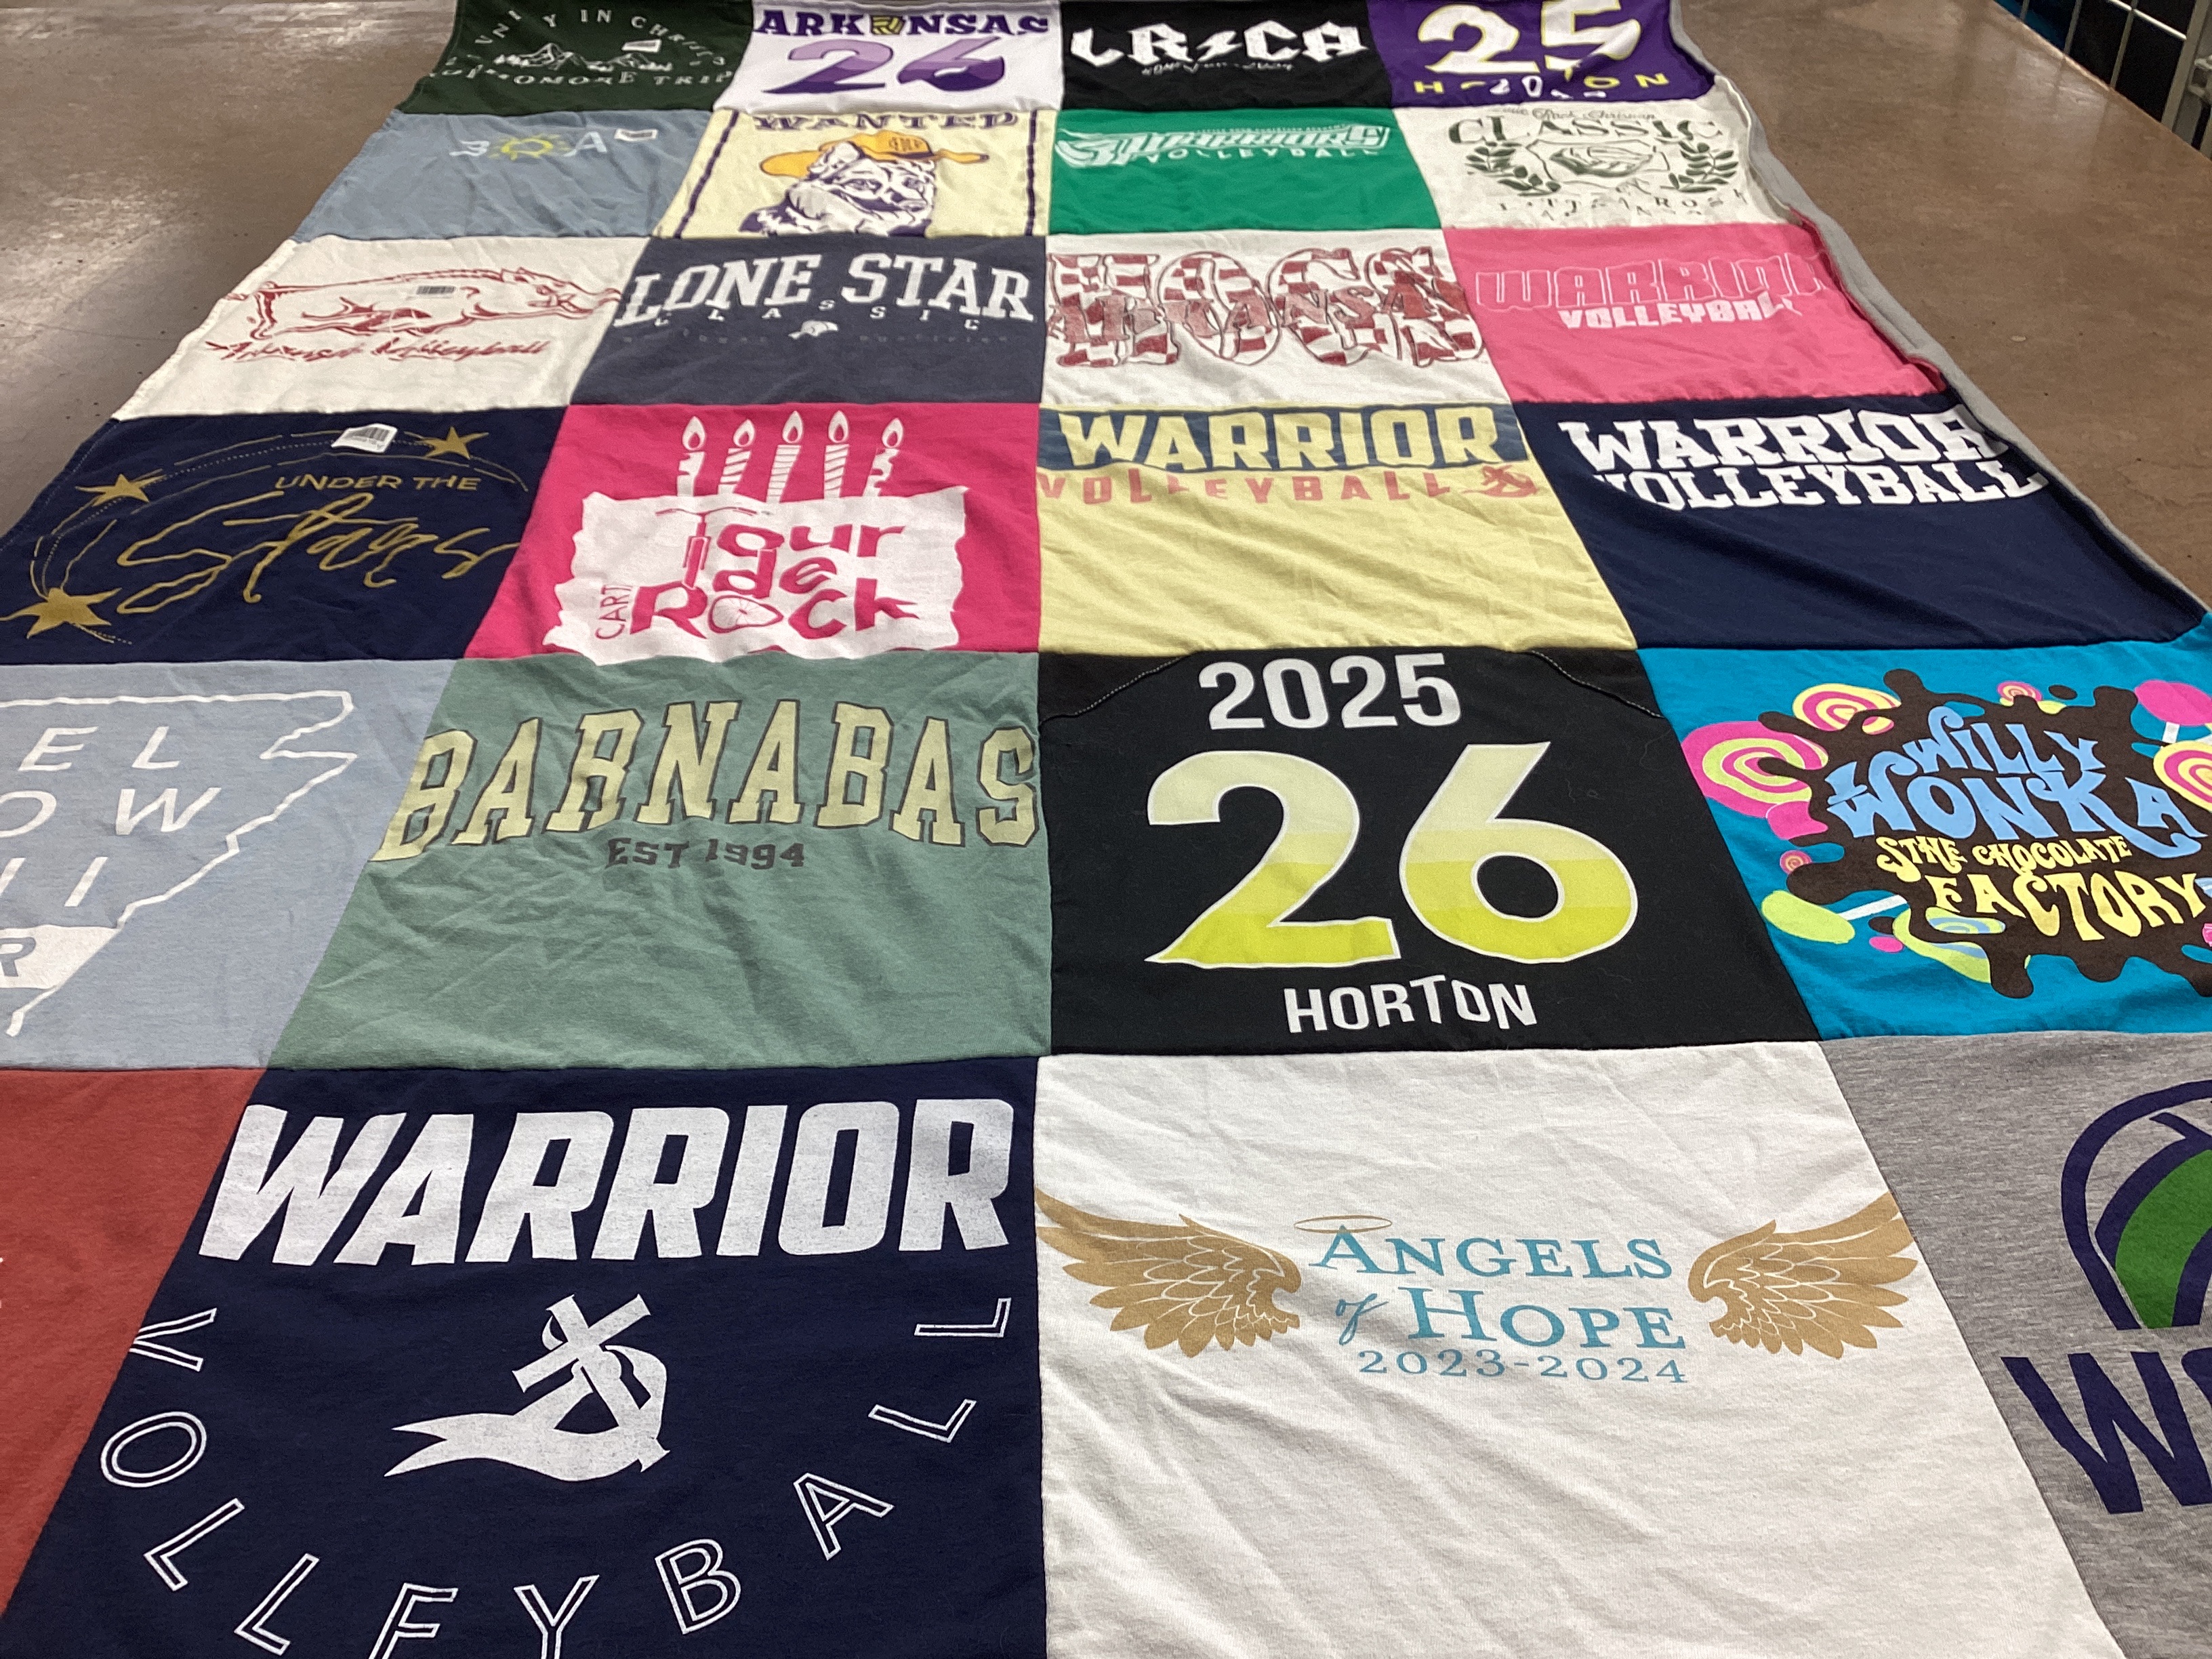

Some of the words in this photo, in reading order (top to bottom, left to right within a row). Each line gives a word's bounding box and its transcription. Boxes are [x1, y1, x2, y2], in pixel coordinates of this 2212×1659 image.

[474, 9, 557, 45] UNIY
[580, 9, 612, 23] IN
[753, 9, 1049, 36] ARKNSAS
[1418, 0, 1641, 73] 25
[653, 70, 733, 85] TRIP
[761, 36, 1005, 94] 26
[754, 112, 1019, 130] WANTED
[1448, 116, 1723, 144] CLASSIC
[613, 253, 823, 327] LONE
[841, 252, 1035, 321] STAR
[654, 300, 979, 331] CLASSIC
[1058, 405, 1500, 470] WARRIOR
[1557, 404, 2009, 472] WARRIOR
[274, 474, 404, 491] UNDER
[413, 476, 482, 491] THE
[1036, 466, 1452, 506] VOLLEYBALL
[1592, 460, 2050, 512] VOLLEYBALL
[117, 492, 520, 615] Stars
[712, 548, 837, 599] de
[630, 577, 922, 640] Rock
[1198, 652, 1462, 731] 2025
[1903, 706, 2105, 775] WILLY
[369, 699, 1039, 863] BARNABAS
[1827, 750, 2208, 859] WONKA
[604, 837, 689, 869] EST
[705, 838, 806, 870] 1994
[1143, 741, 1639, 970] 26
[1971, 836, 2133, 874] CHOCOLATE
[1924, 869, 2208, 941] FACTORY
[1283, 974, 1538, 1033] HORTON
[199, 1097, 1015, 1266] WARRIOR
[1309, 1224, 1673, 1280] ANGELS
[1334, 1292, 1391, 1346] of
[1396, 1285, 1687, 1350] HOPE
[1357, 1350, 1689, 1385] 2023-2024
[100, 1297, 1012, 1659] VOLLEYBALL
